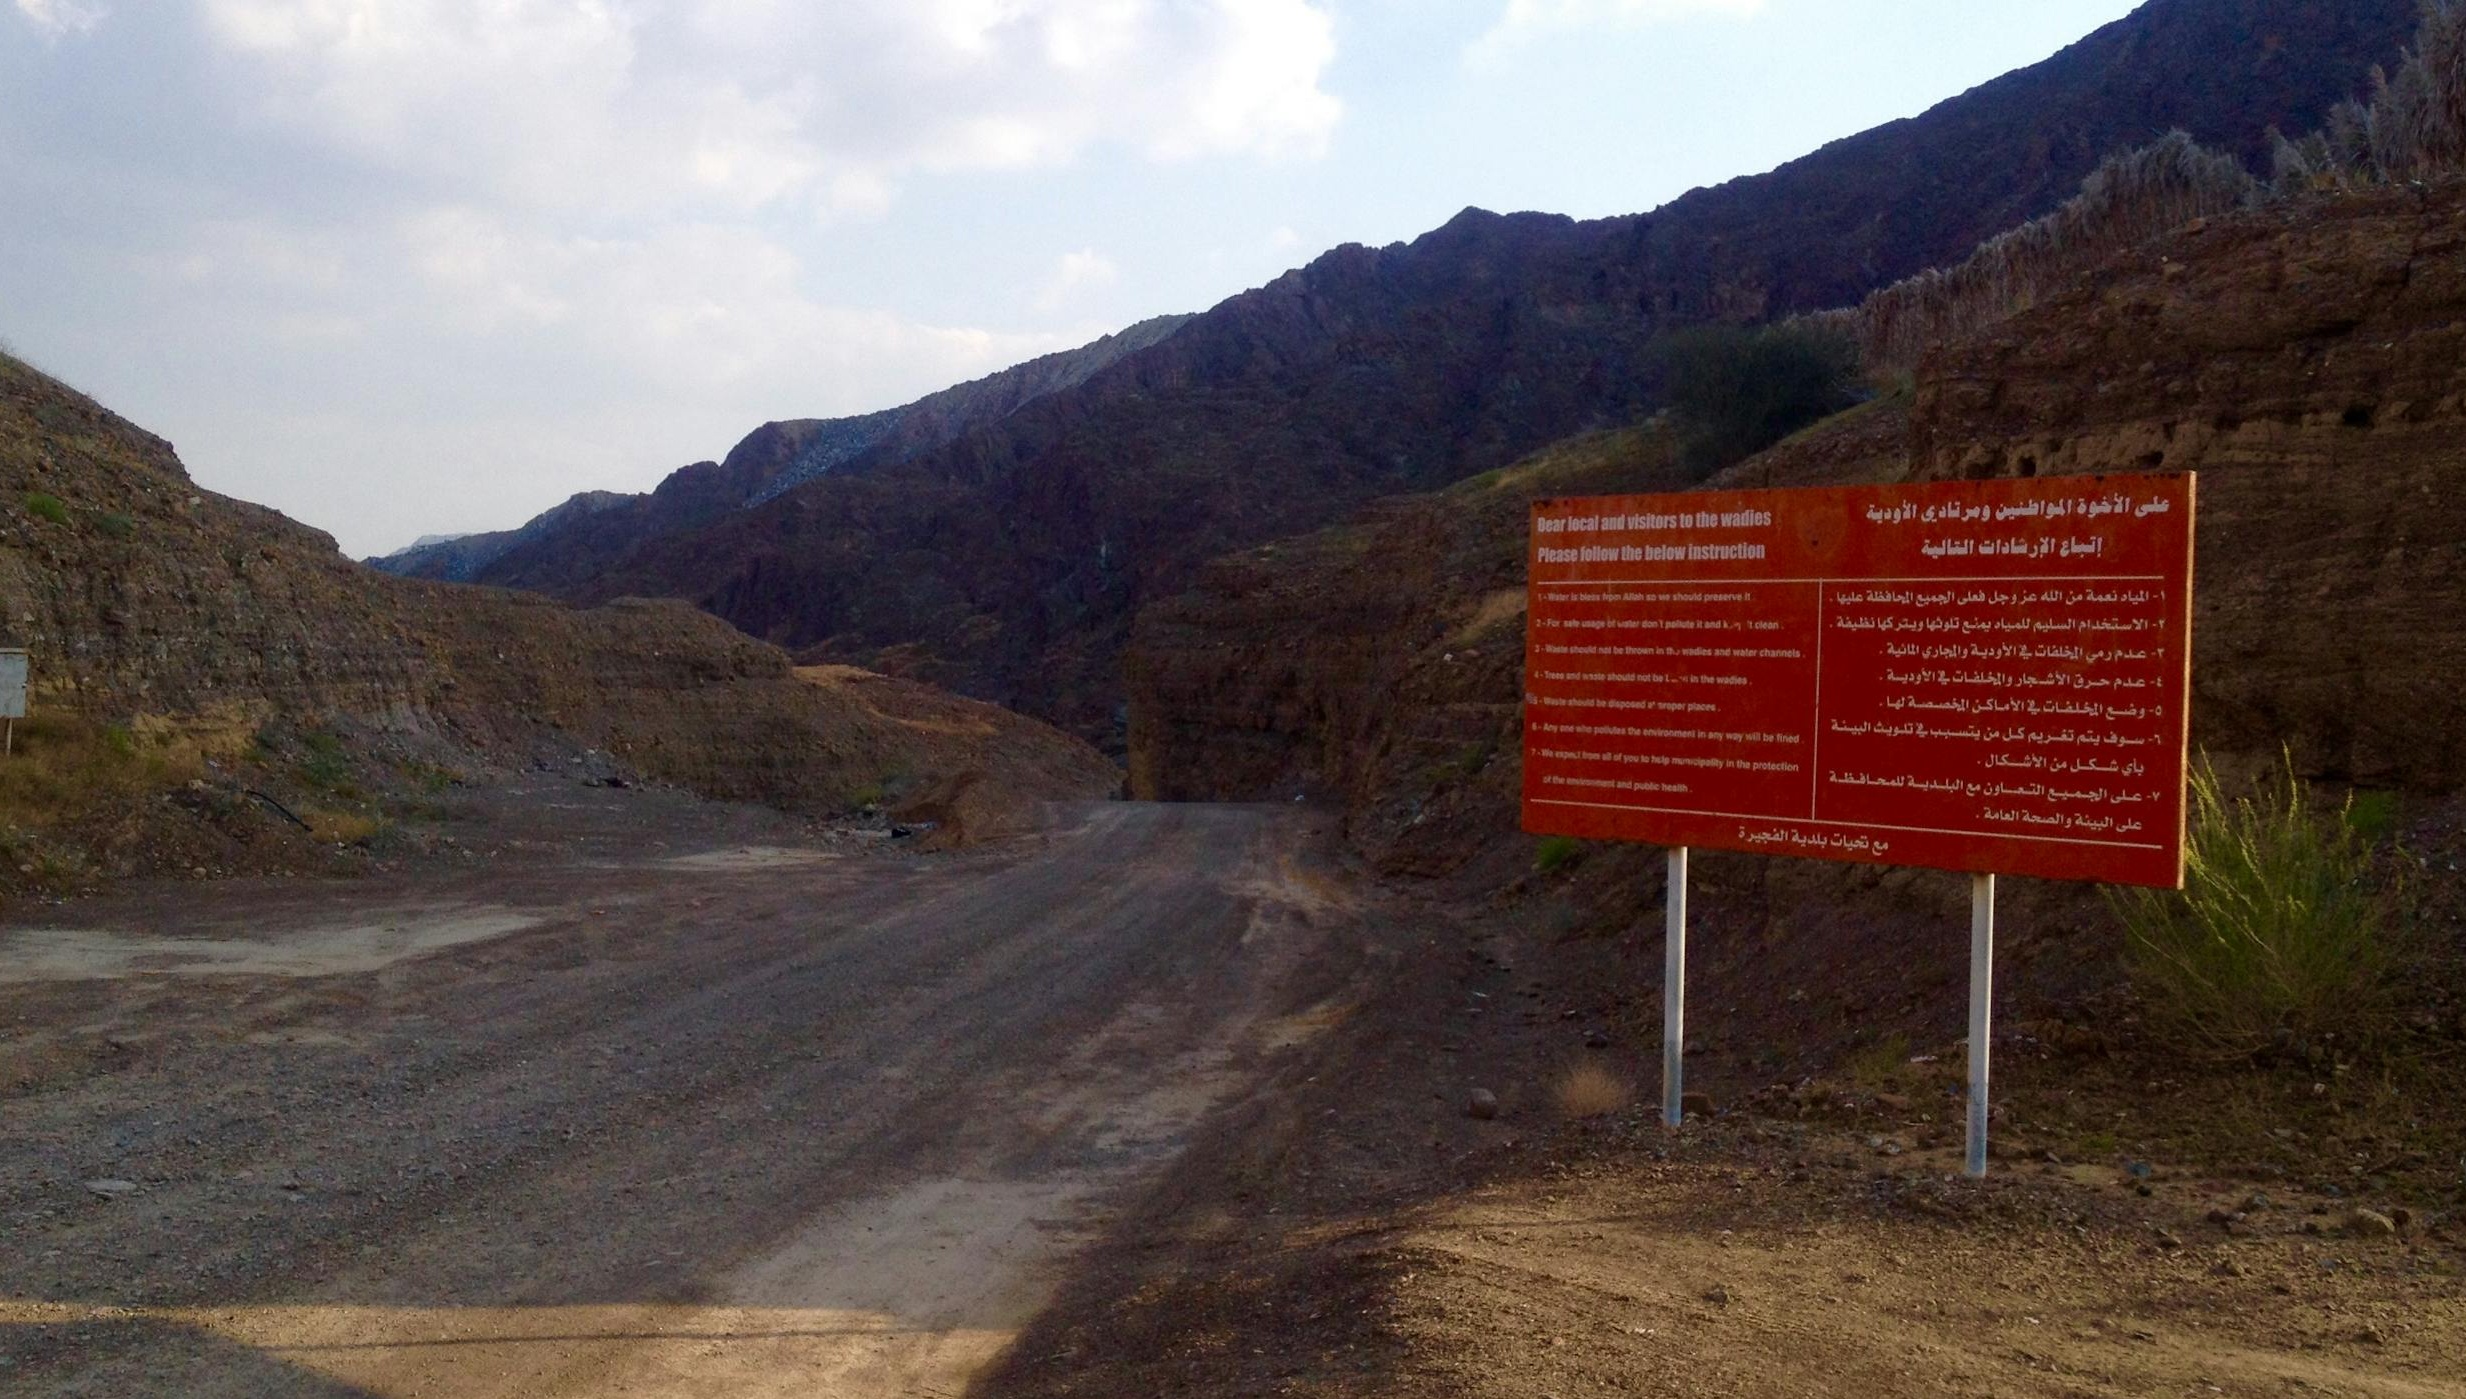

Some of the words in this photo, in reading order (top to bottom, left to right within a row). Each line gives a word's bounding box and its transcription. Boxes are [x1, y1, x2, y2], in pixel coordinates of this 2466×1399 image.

[1866, 499, 1917, 524] الأودية
[1921, 501, 1991, 523] ومرتادي
[1995, 498, 2072, 521] المواطنين
[2076, 492, 2131, 519] الأخوة
[2134, 496, 2170, 518] على
[1538, 516, 1566, 533] Dear
[1568, 515, 1599, 532] local
[1601, 514, 1625, 531] and
[1627, 512, 1677, 530] visitors
[1680, 512, 1693, 529] to
[1695, 510, 1718, 528] the
[1720, 509, 1772, 527] wadies
[1538, 546, 1578, 563] Please
[1580, 545, 1619, 562] follow
[1621, 544, 1643, 561] the
[1645, 544, 1687, 561] below
[1688, 542, 1765, 560] instruction
[1921, 538, 1974, 559] التالية
[1979, 536, 2056, 559] الإرشادات
[2060, 536, 2103, 558] إتباع
[1548, 593, 1569, 601] Water
[1571, 593, 1578, 601] is
[1602, 592, 1621, 602] from
[1622, 592, 1644, 601] Allah
[1672, 592, 1702, 601] should
[1704, 593, 1743, 603] preserve
[1744, 592, 1751, 601] it
[1836, 591, 1864, 605] عليها
[1866, 590, 1913, 604] المحافظة
[1915, 592, 1954, 607] الجميع
[1957, 590, 1985, 606] فعلى
[2020, 590, 2037, 605] عز
[2040, 590, 2063, 602] الله
[2065, 590, 2083, 605] من
[2086, 588, 2118, 602] نعمة
[2120, 590, 2149, 605] المياه
[1547, 619, 1560, 628] For
[1581, 621, 1605, 630] usage
[1617, 620, 1640, 629] water
[1697, 620, 1704, 629] it
[1705, 620, 1721, 629] and
[1755, 620, 1779, 630] clean
[1837, 615, 1875, 631] نظيفة
[1926, 616, 1960, 632] تلوثها
[2033, 618, 2076, 633] السليم
[2078, 618, 2148, 633] الاستخدام
[1545, 645, 1568, 654] Waste
[1569, 646, 1597, 655] should
[1598, 646, 1612, 655] not
[1613, 646, 1624, 655] be
[1656, 647, 1664, 656] in
[1682, 647, 1712, 656] wadies
[1714, 648, 1730, 657] and
[1732, 648, 1757, 658] water
[1759, 648, 1800, 659] channels
[1971, 642, 2016, 660] الأودية
[2019, 644, 2032, 660] في
[2034, 644, 2083, 661] المخلفات
[2086, 649, 2112, 664] رمي
[2115, 648, 2147, 662] عدم
[1566, 672, 1580, 681] and
[1582, 672, 1606, 681] waste
[1607, 673, 1635, 682] should
[1637, 673, 1651, 682] not
[1652, 673, 1663, 682] be
[1690, 675, 1699, 684] in
[1700, 675, 1715, 684] the
[1716, 676, 1748, 686] wadies
[1887, 667, 1936, 685] الأودية
[1938, 669, 1951, 686] في
[1952, 670, 2013, 687] والمخلفات
[2016, 671, 2071, 688] الأشجار
[2073, 673, 2110, 689] حرق
[2114, 676, 2145, 690] عدم
[1544, 697, 1566, 706] Waste
[1568, 697, 1595, 707] should
[1596, 698, 1607, 708] be
[1608, 698, 1646, 710] disposed
[1688, 702, 1716, 712] places
[1887, 695, 1905, 711] لها
[1908, 695, 1969, 713] المخصصة
[1972, 696, 2025, 714] الأماكن
[2027, 699, 2041, 715] في
[2043, 699, 2103, 717] المخلفات
[2105, 703, 2146, 720] وضع
[1543, 723, 1558, 733] Any
[1560, 724, 1574, 733] one
[1576, 724, 1592, 734] who
[1594, 725, 1626, 736] pollutes
[1627, 726, 1641, 736] the
[1697, 729, 1706, 739] in
[1708, 731, 1723, 742] any
[1725, 732, 1743, 743] way
[1745, 732, 1761, 742] will
[1763, 733, 1774, 743] be
[1776, 734, 1800, 744] fined
[1873, 721, 1914, 737] تلويث
[1915, 722, 1928, 738] في
[1930, 725, 1980, 741] يتسبب
[1983, 726, 2000, 742] من
[2002, 727, 2026, 742] كل
[2028, 728, 2074, 745] تغريم
[2077, 730, 2100, 746] يتم
[2103, 731, 2145, 748] سوف
[1541, 748, 1553, 758] We
[1582, 750, 1600, 761] from
[1602, 751, 1612, 761] all
[1613, 752, 1622, 761] of
[1623, 753, 1640, 764] you
[1641, 754, 1650, 763] to
[1651, 755, 1670, 767] help
[1671, 756, 1723, 769] municipality
[1726, 759, 1735, 769] in
[1736, 760, 1751, 770] the
[1752, 761, 1799, 773] protection
[1985, 752, 2047, 769] الأشكال
[2050, 757, 2068, 772] من
[2069, 757, 2118, 773] شكل
[1543, 775, 1552, 784] of
[1552, 775, 1566, 785] the
[1616, 780, 1633, 790] and
[1634, 780, 1660, 792] public
[1661, 782, 1689, 793] health
[1829, 770, 1905, 788] للمحافظة
[1908, 775, 1964, 793] البلدية
[1966, 782, 1981, 796] مع
[1983, 781, 2045, 798] التعاون
[2047, 786, 2108, 803] الجميع
[2110, 788, 2143, 804] على
[1983, 806, 2020, 822] العامة
[2022, 808, 2071, 829] والصحة
[2116, 817, 2143, 833] على
[1738, 825, 1789, 845] الفجيرة
[1791, 828, 1827, 848] بلدية
[1830, 833, 1870, 852] تحيات
[1872, 839, 1889, 856] مع
